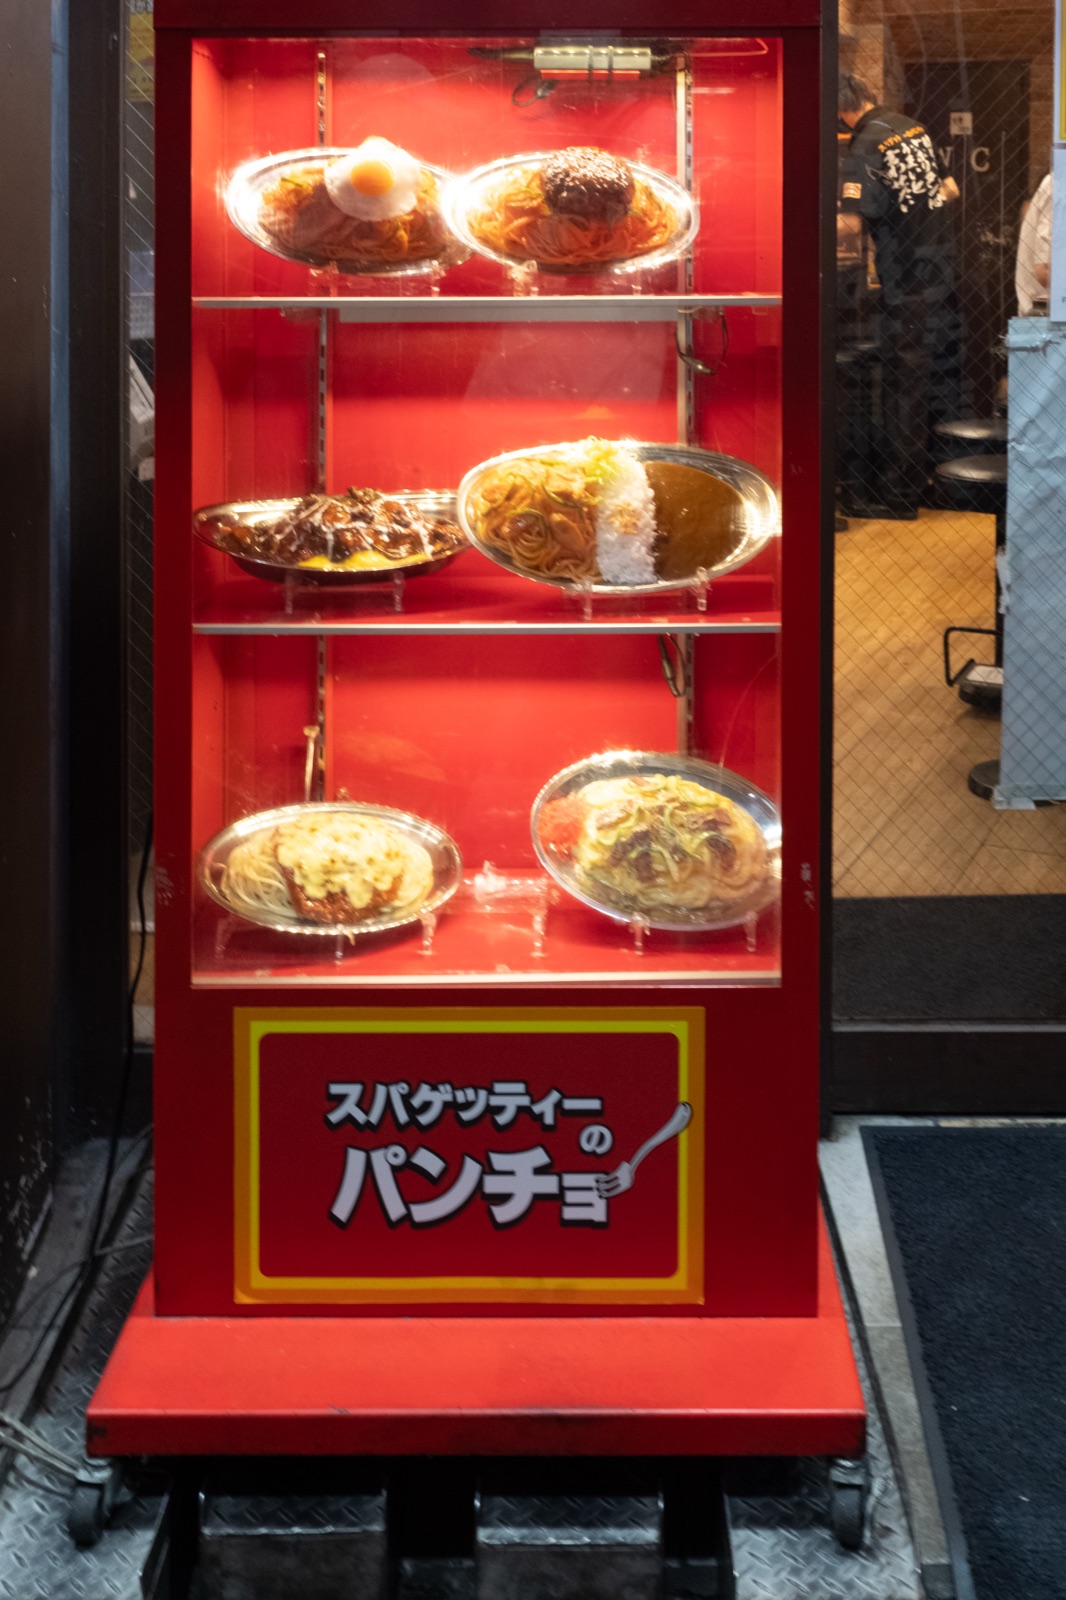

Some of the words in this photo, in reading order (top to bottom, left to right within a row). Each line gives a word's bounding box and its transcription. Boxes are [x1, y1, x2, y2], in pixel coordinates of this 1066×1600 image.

[326, 1081, 603, 1128] スパゲッティー
[579, 1124, 613, 1155] の
[329, 1144, 609, 1225] パンチョ
